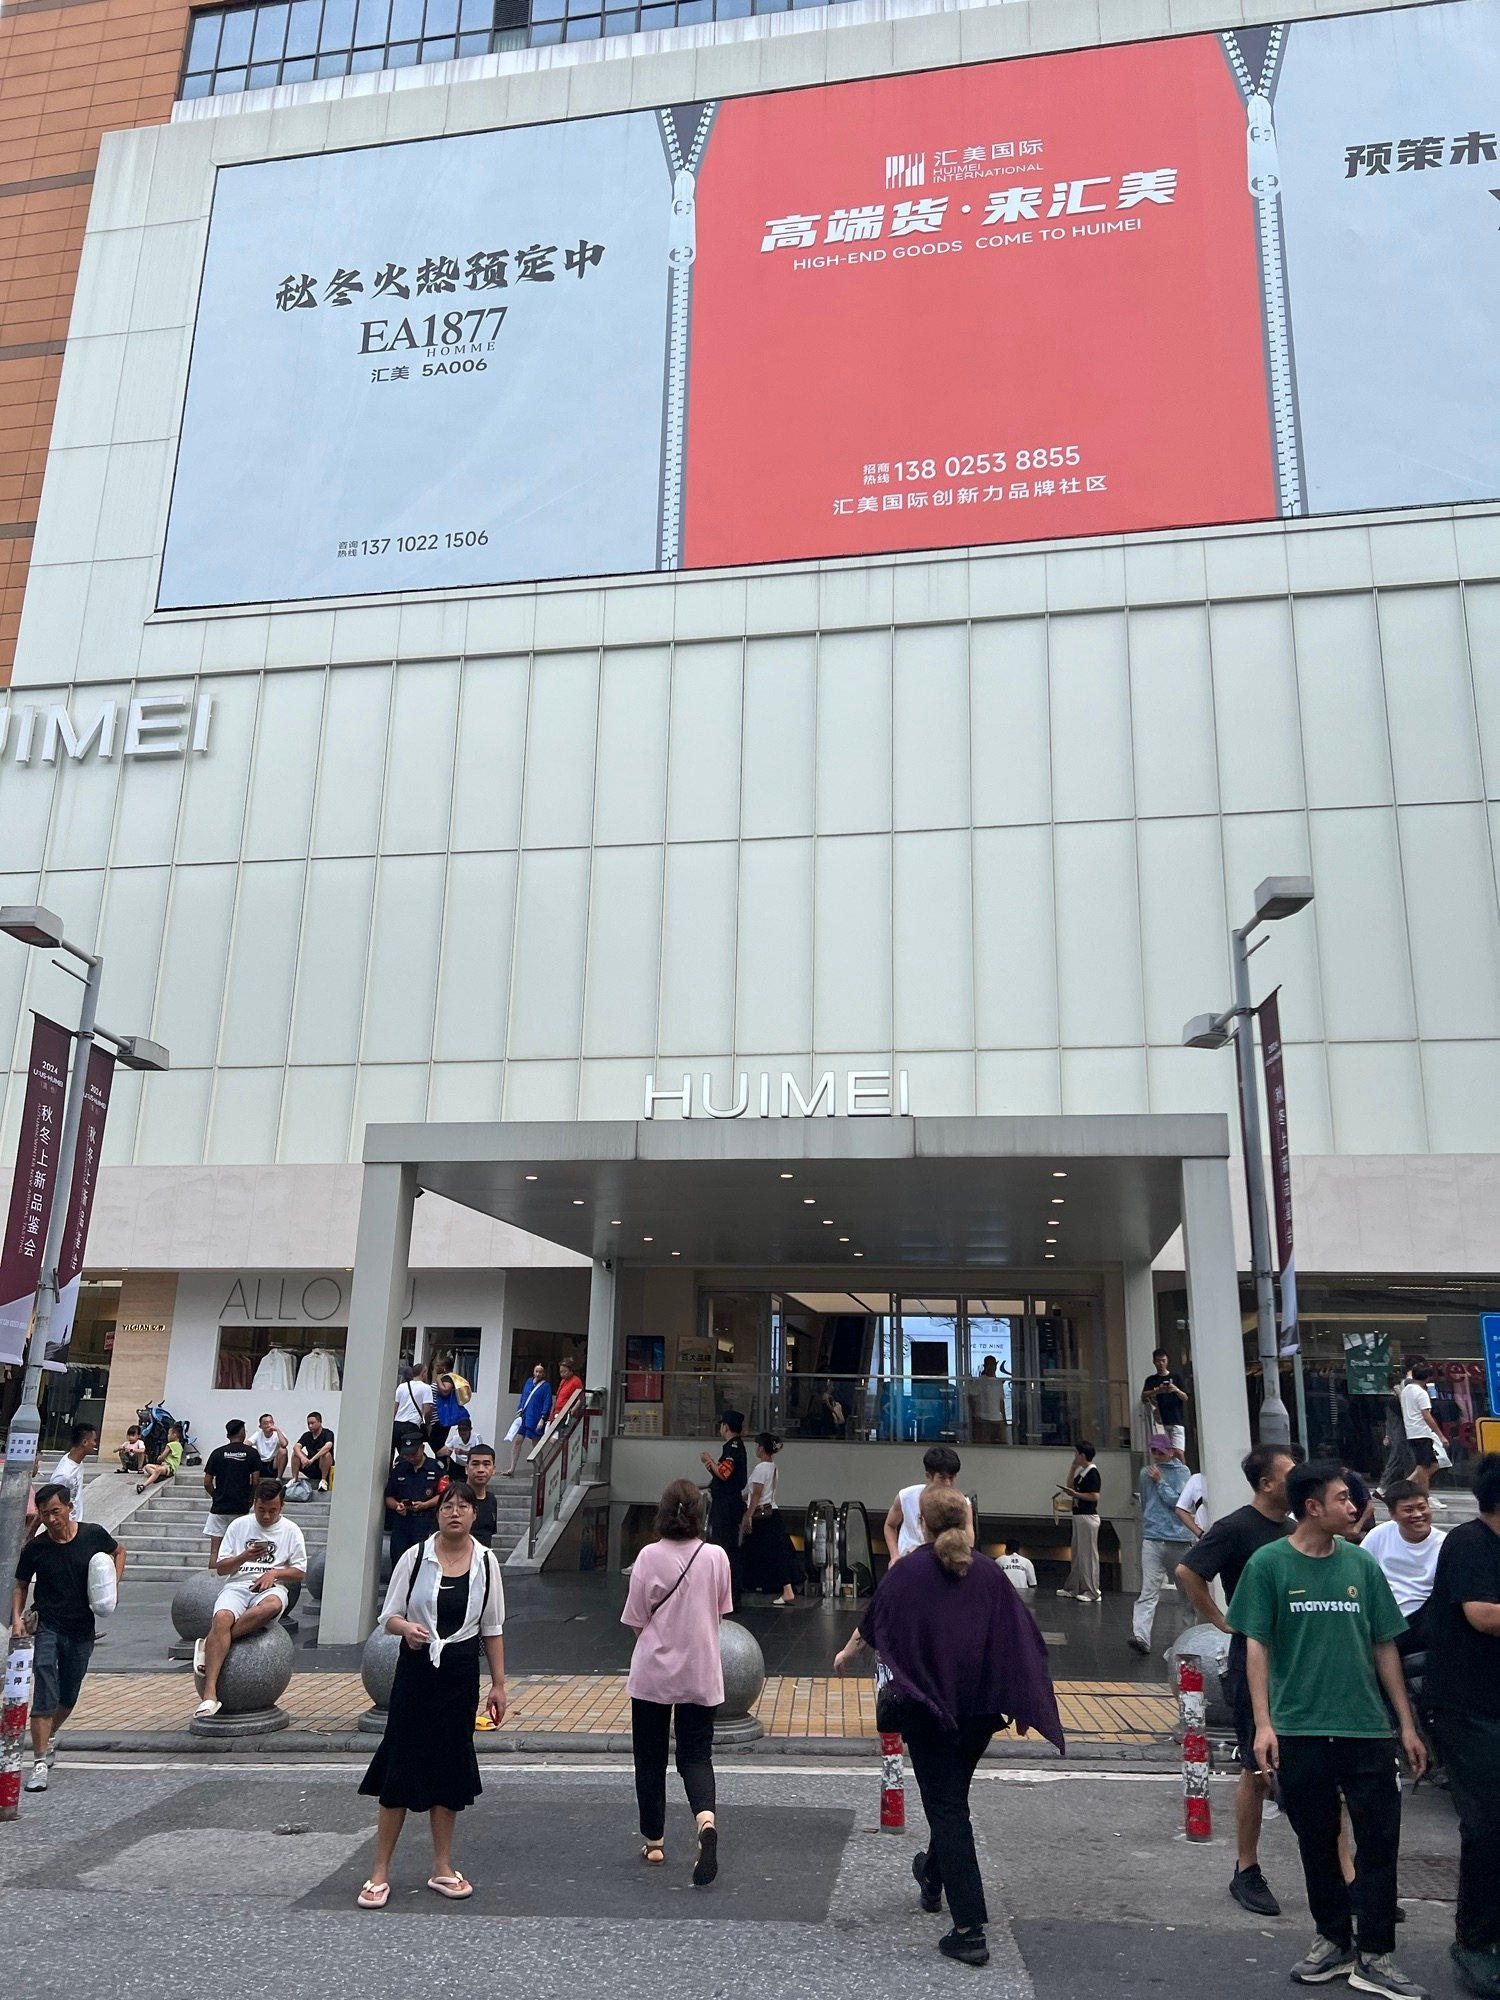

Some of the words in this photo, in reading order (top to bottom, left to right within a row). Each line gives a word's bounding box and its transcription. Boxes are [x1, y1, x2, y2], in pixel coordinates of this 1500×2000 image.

[934, 138, 1044, 167] 汇美国际
[933, 164, 981, 177] HUIMEI
[933, 163, 1044, 184] INTERNATIONAL
[793, 249, 887, 270] HIGH-END
[893, 240, 962, 258] GOODS
[975, 233, 1034, 249] COME
[1039, 228, 1066, 242] TO
[1072, 218, 1142, 238] HUIMEI
[275, 240, 606, 312] 秋冬火热预定中
[357, 306, 508, 355] EA1877
[426, 341, 496, 358] HOMME
[371, 365, 410, 383] 汇美
[422, 358, 488, 377] 5A006
[863, 463, 890, 474] 招商
[894, 459, 936, 482] 138
[945, 452, 1007, 477] 0253
[1016, 445, 1081, 470] 8855
[863, 474, 890, 486] 热线
[832, 475, 1108, 516] 汇美国际创新力品牌社区
[361, 538, 391, 556] 137
[397, 534, 439, 553] 1022
[445, 530, 489, 549] 1506
[42, 1061, 58, 1075] 2024
[644, 1070, 909, 1119] HUIMEI
[24, 1104, 53, 1258] 秋冬上新品鉴会
